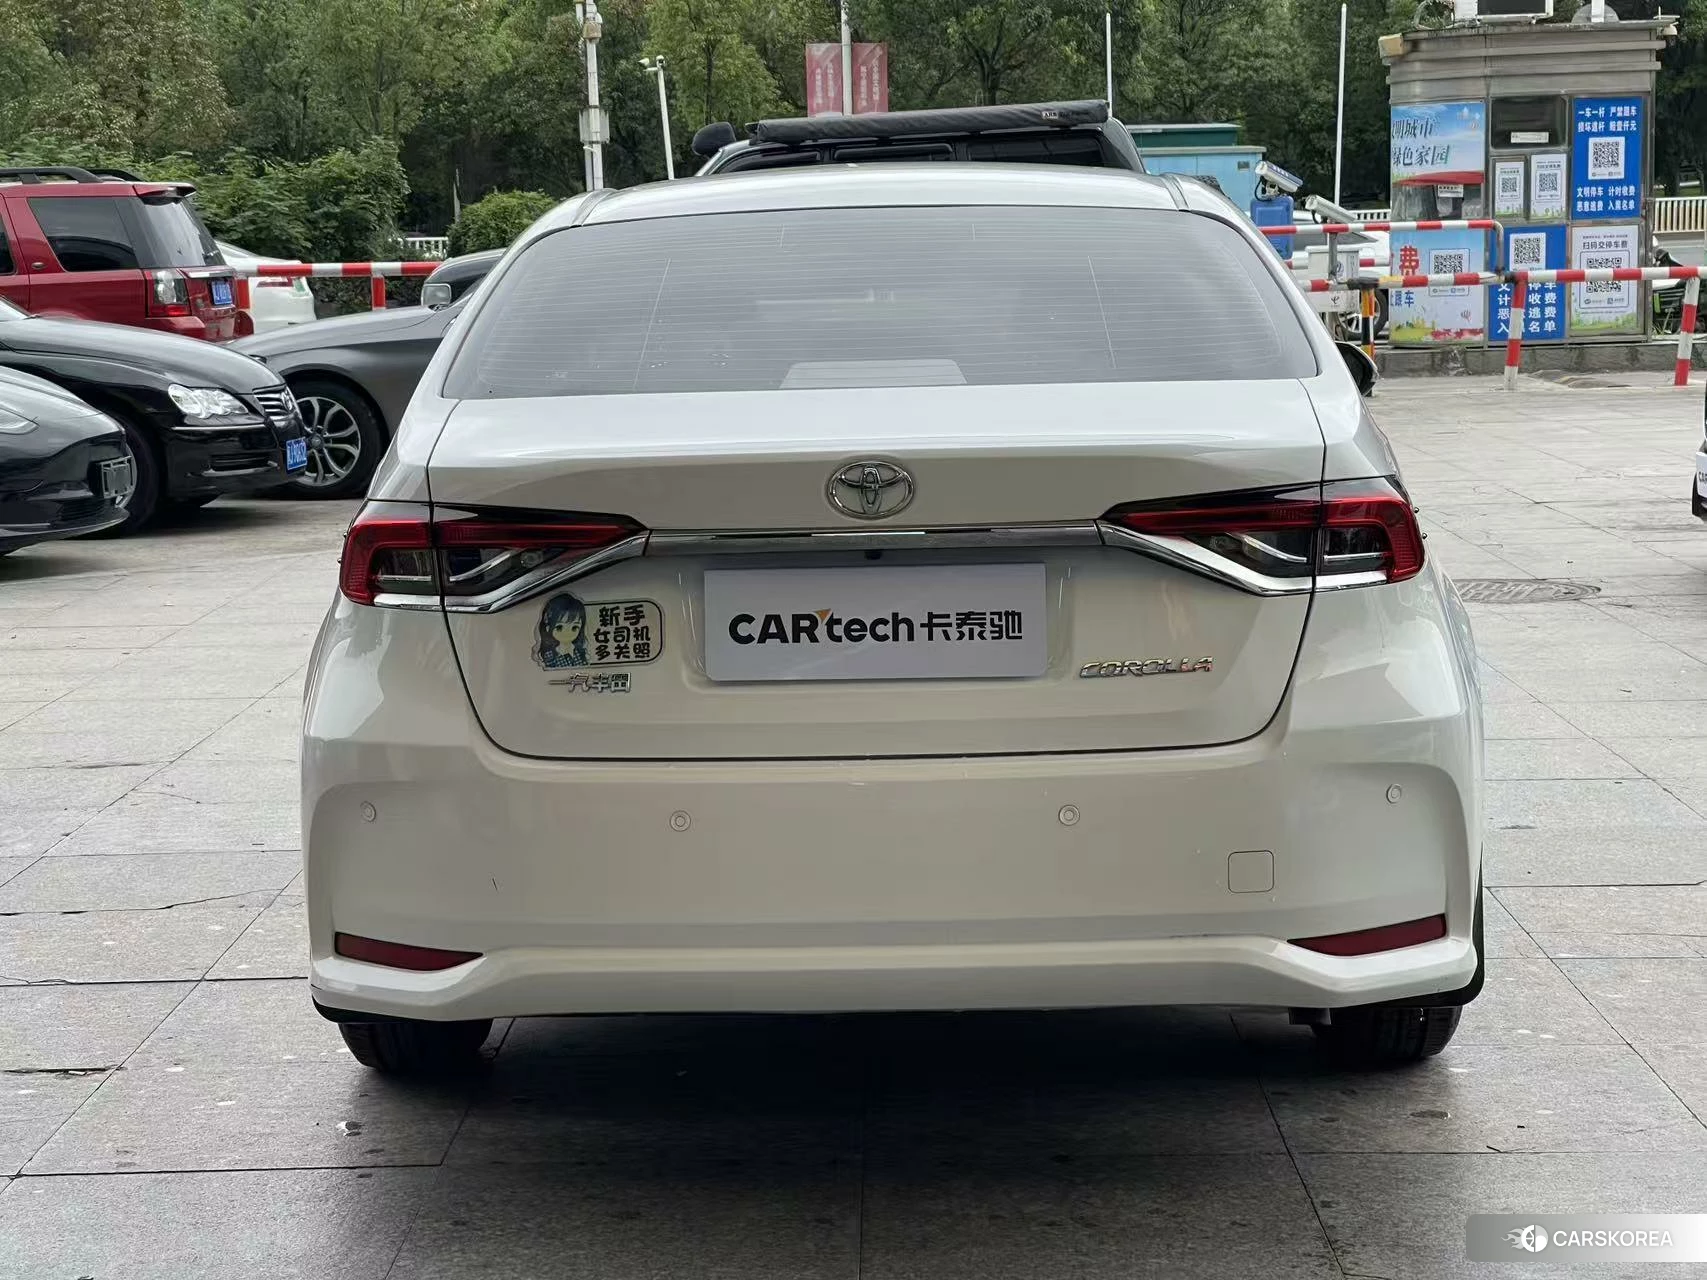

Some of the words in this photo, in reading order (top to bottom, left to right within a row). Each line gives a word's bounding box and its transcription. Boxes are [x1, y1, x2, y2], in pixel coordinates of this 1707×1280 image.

[1497, 292, 1557, 305] 计收费
[1498, 306, 1557, 319] 恶逃费
[1497, 320, 1557, 333] 入名单
[599, 604, 645, 627] 新手
[593, 626, 651, 643] 女司机
[728, 610, 915, 645] CARtech
[920, 611, 1023, 641] 卡泰驰
[595, 642, 651, 661] 多关照
[1080, 657, 1213, 678] COROLLA
